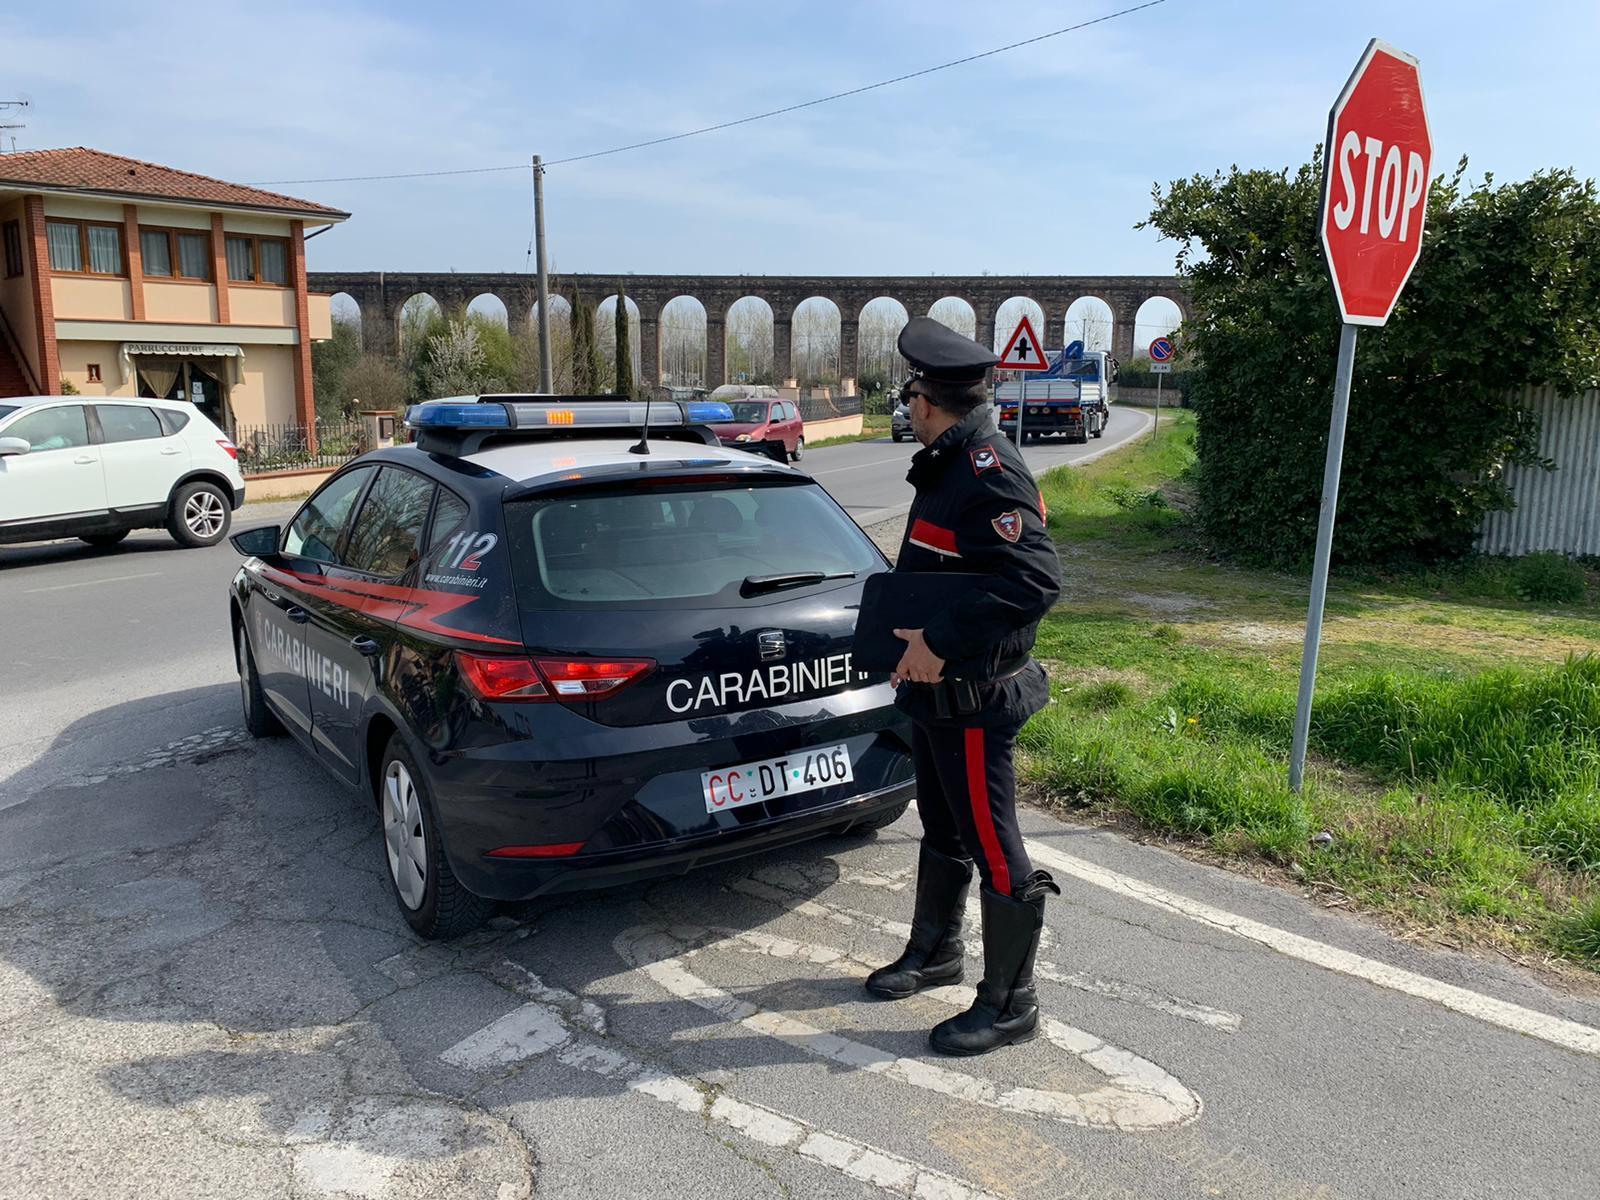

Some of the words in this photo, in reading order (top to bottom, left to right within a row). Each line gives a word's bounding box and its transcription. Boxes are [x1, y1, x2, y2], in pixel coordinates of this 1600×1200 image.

[1333, 131, 1424, 242] STOP
[128, 344, 204, 354] PARRUCCHIERE
[439, 530, 498, 571] 112
[425, 573, 488, 588] www.carabinieri.it
[264, 619, 349, 709] CARABINIERI
[666, 652, 869, 714] CARABINIE
[709, 771, 744, 807] CC
[758, 760, 789, 796] DT
[803, 750, 847, 786] 406
